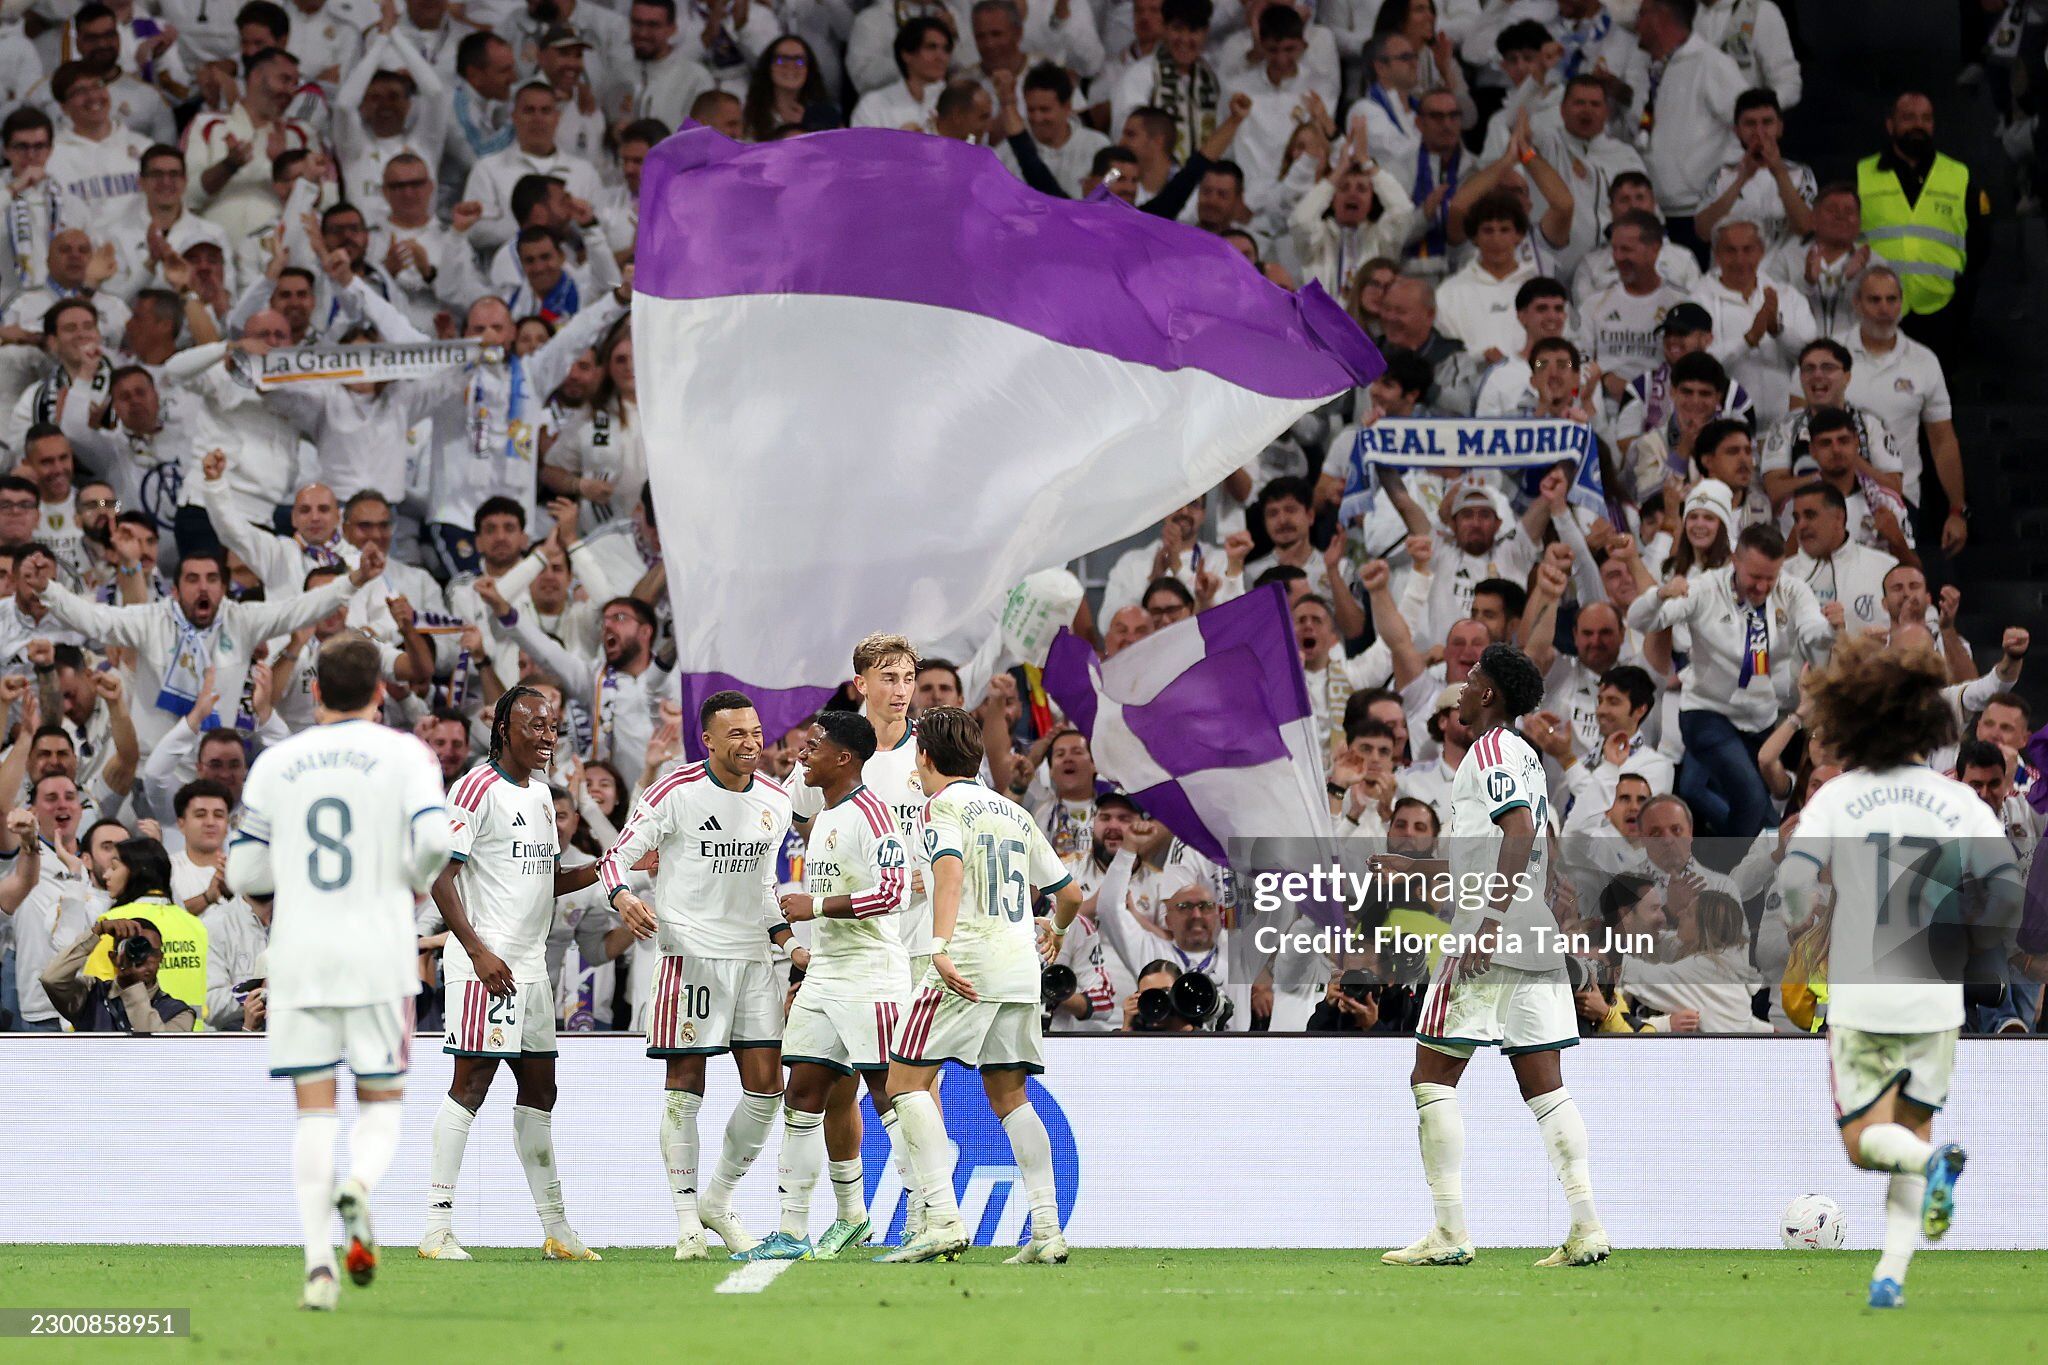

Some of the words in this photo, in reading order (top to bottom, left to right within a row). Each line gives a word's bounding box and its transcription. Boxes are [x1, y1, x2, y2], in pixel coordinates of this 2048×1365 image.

[262, 353, 290, 373] La
[296, 349, 361, 371] Gran
[1361, 428, 1445, 455] REAL
[1457, 426, 1588, 456] MADRID
[1490, 772, 1514, 802] hp
[961, 800, 987, 829] ARDA
[989, 799, 1031, 837] GÜLER
[1845, 785, 1962, 831] CUCURELLA
[307, 797, 352, 891] 8
[512, 840, 553, 858] Emirate
[880, 839, 902, 867] hp
[522, 861, 536, 874] FLY
[711, 860, 728, 873] FLY
[808, 859, 841, 877] irates
[976, 833, 1026, 922] 15
[1866, 832, 1942, 927] 17
[162, 940, 196, 953] VICIOS
[488, 991, 515, 1025] 25
[684, 984, 710, 1019] 10
